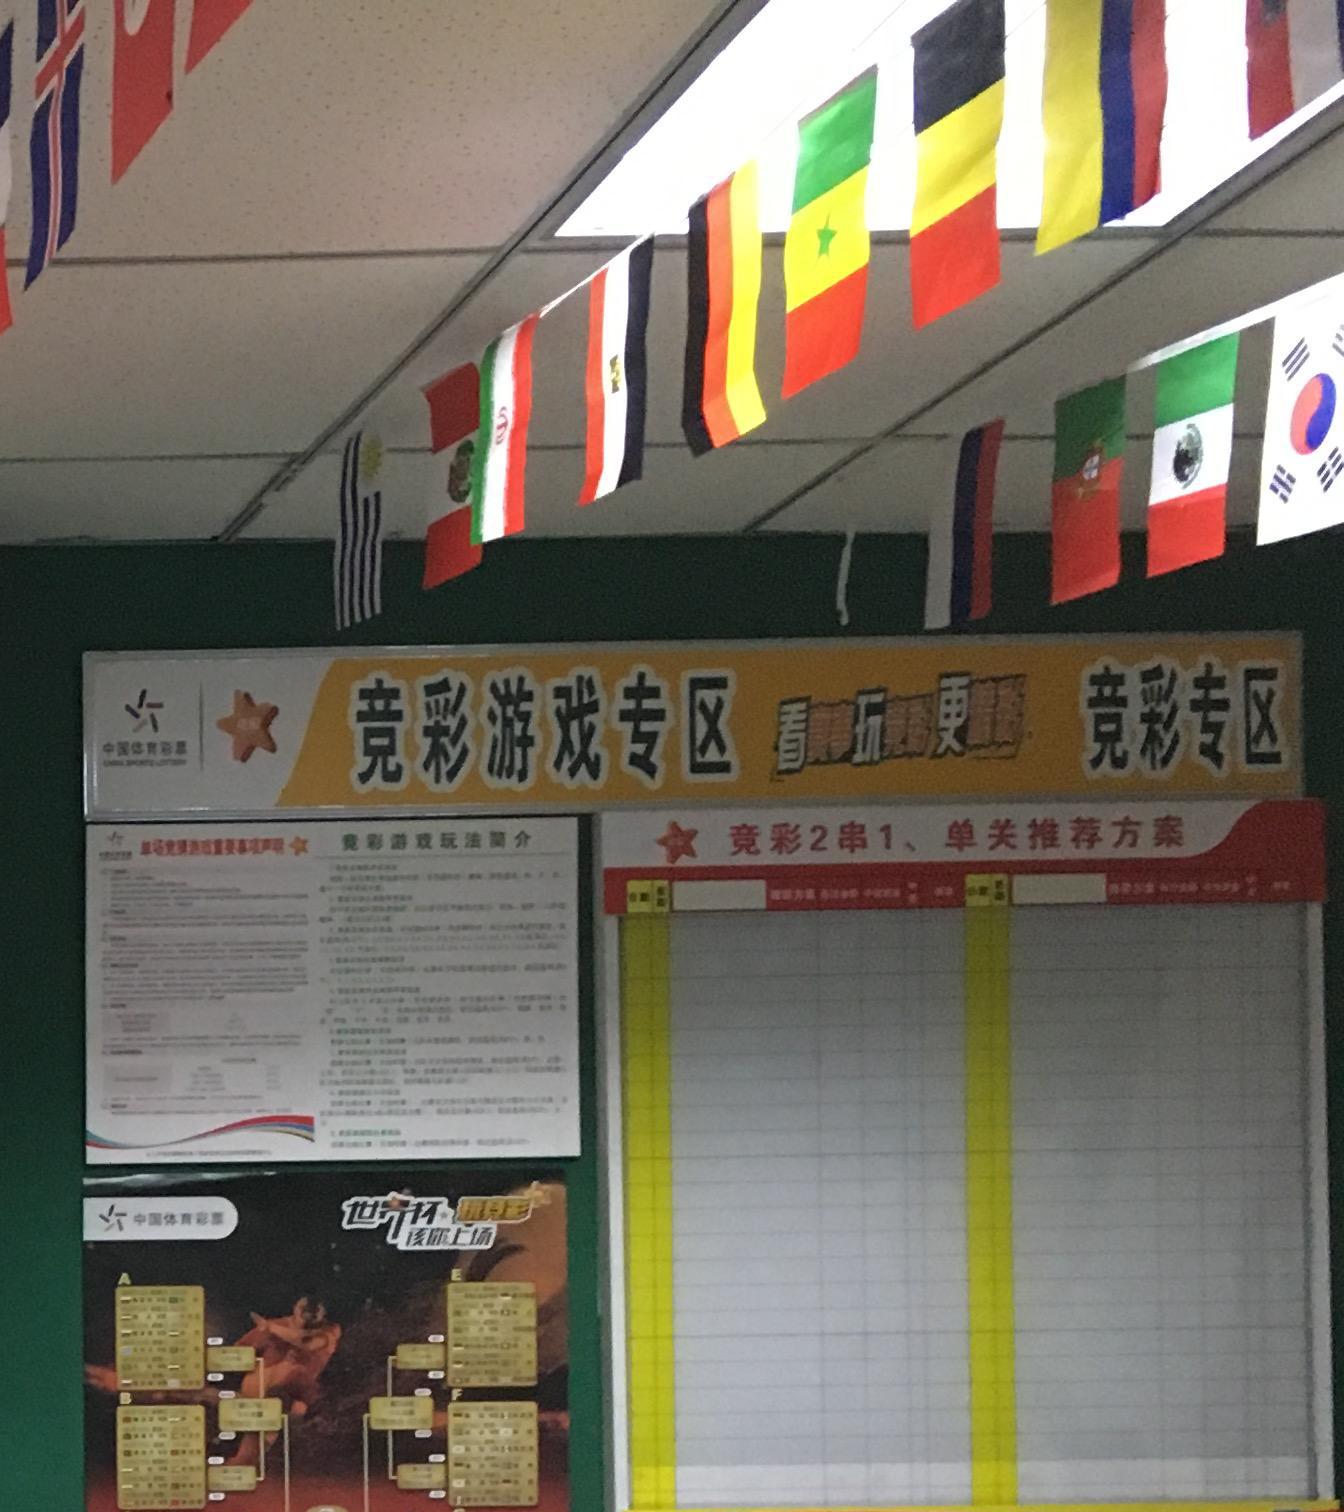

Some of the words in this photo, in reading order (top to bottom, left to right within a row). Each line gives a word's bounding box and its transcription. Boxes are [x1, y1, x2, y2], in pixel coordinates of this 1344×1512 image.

[353, 666, 738, 788] 竞彩游戏专区
[1082, 660, 1286, 778] 竞彩专区
